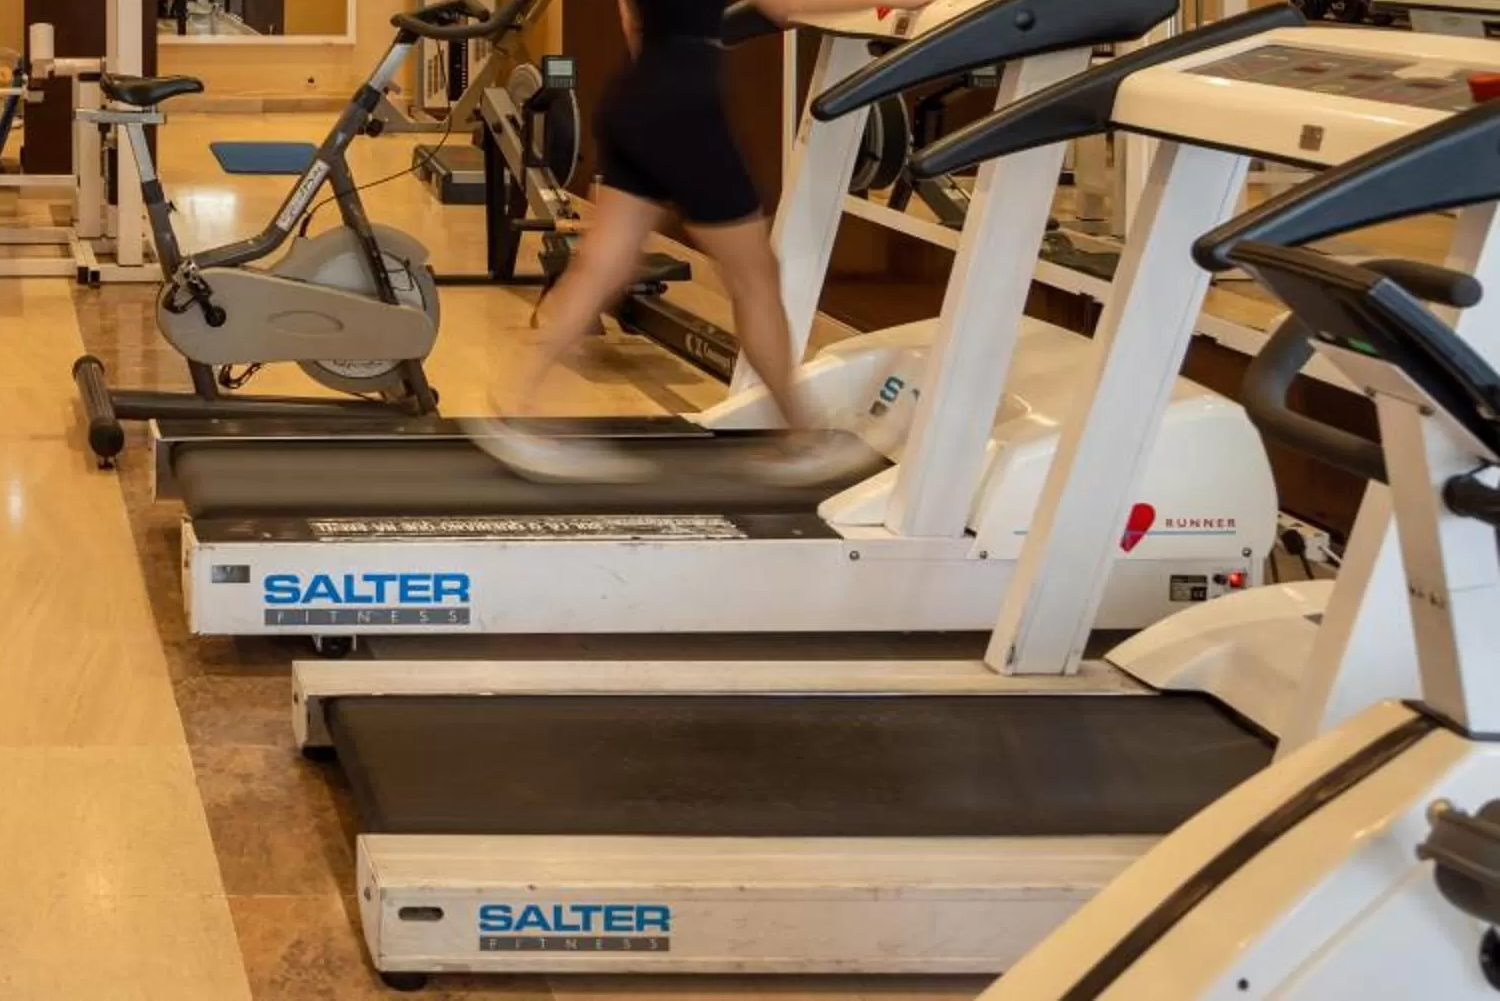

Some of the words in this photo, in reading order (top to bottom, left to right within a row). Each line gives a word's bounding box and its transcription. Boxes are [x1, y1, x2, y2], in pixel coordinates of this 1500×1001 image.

[1165, 518, 1236, 528] RUNNER
[263, 574, 471, 604] SALTER
[272, 609, 462, 625] FITNESS
[479, 904, 671, 932] SALTER
[487, 937, 660, 950] FITNESS
